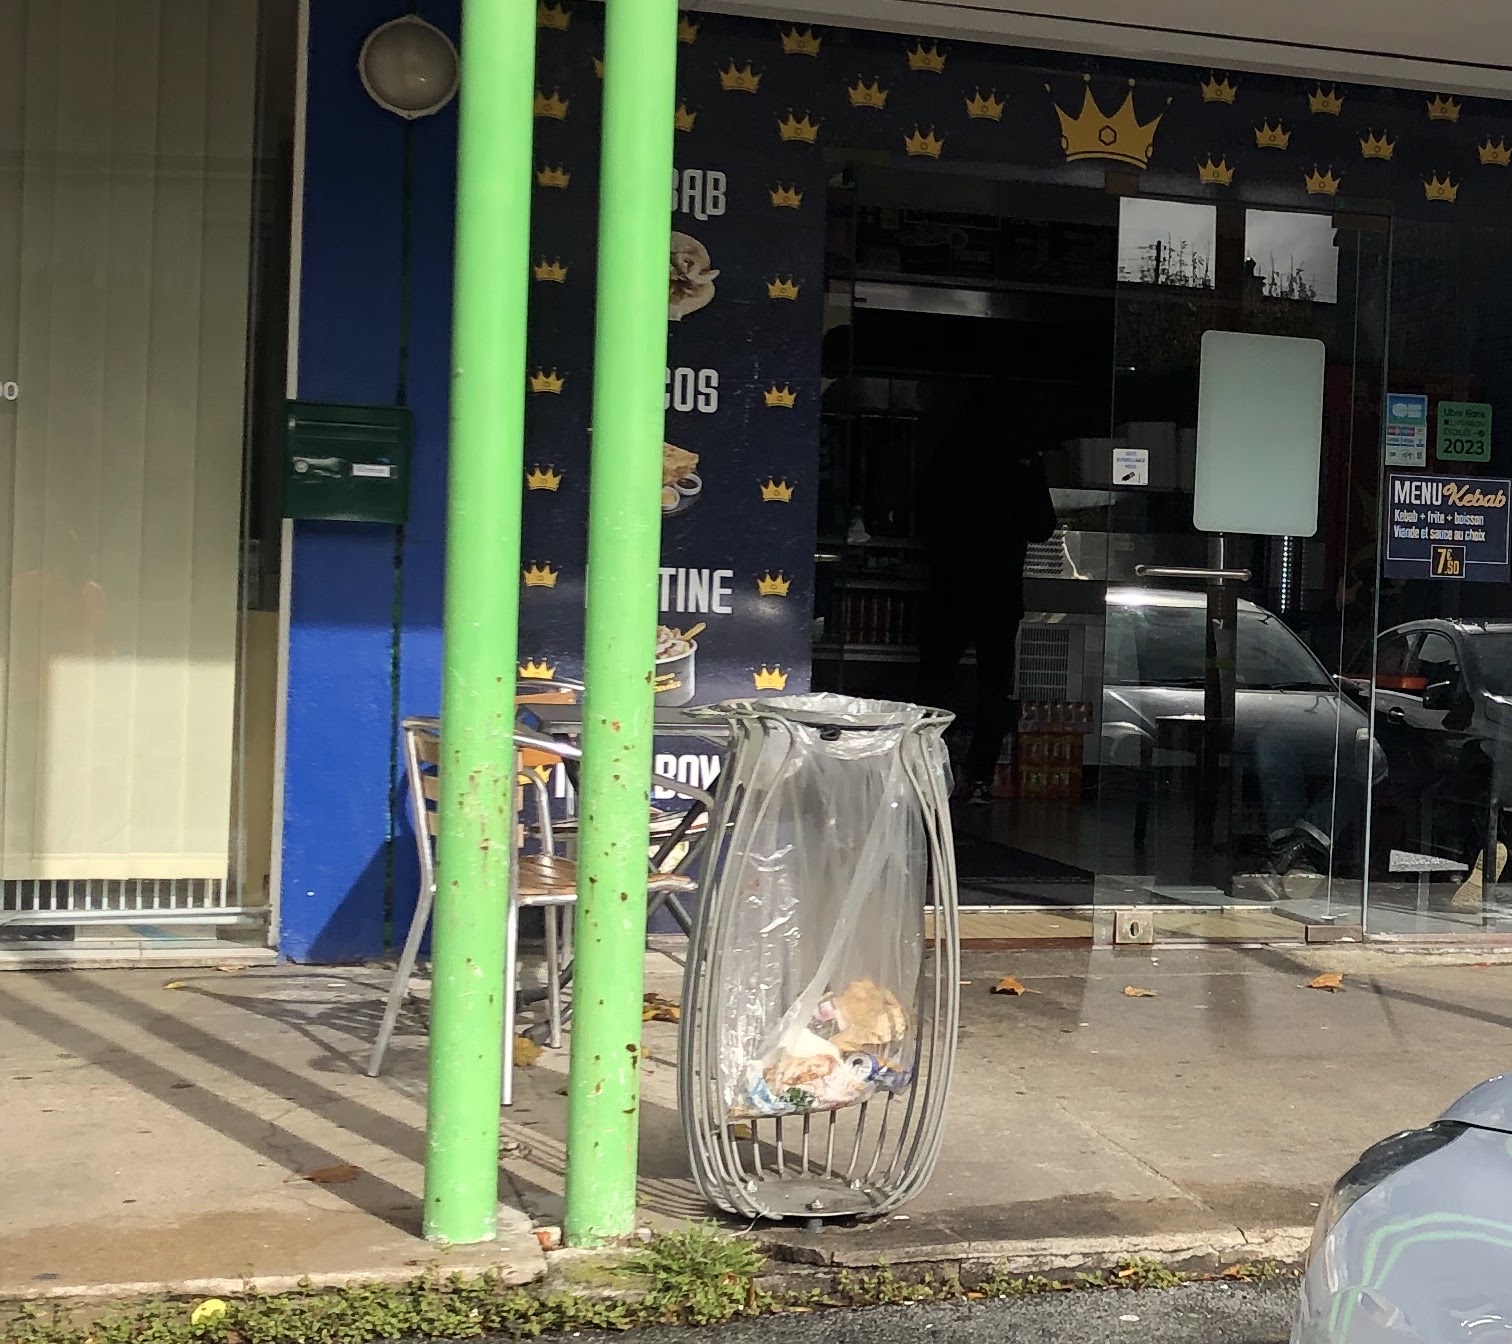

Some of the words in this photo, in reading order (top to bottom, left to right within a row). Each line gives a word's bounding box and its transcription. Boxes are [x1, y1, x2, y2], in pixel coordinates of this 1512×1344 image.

[1442, 439, 1485, 456] 2023
[1394, 480, 1443, 506] MENU
[1442, 482, 1507, 508] Kebab
[1394, 509, 1418, 523] Kebab
[1427, 511, 1445, 524] frite
[1454, 512, 1484, 525] boisson
[1393, 524, 1420, 539] Viande
[1420, 526, 1429, 539] et
[1430, 529, 1453, 540] sauce
[1453, 530, 1464, 541] au
[1464, 529, 1486, 542] choix
